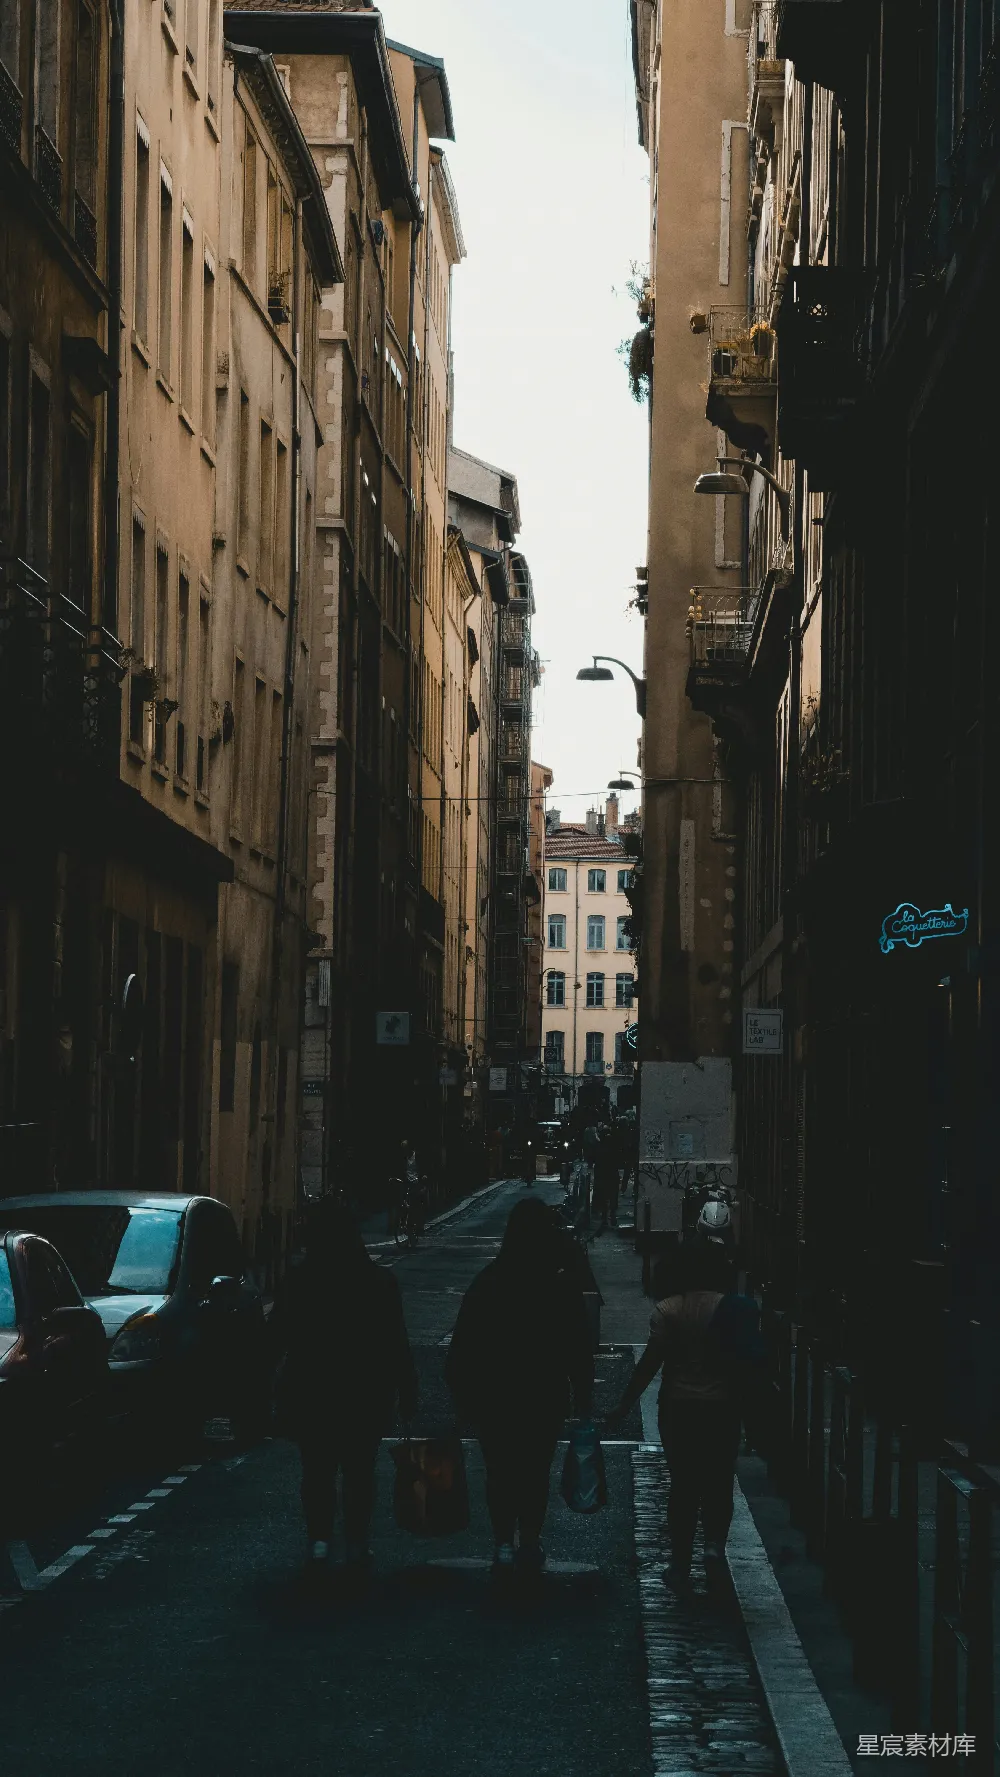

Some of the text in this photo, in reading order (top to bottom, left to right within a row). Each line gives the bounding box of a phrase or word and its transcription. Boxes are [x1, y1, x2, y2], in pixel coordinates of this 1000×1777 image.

[891, 916, 957, 941] Coquetterie
[749, 1019, 759, 1027] LE
[749, 1027, 777, 1036] TEXTILE
[749, 1036, 764, 1044] LAB
